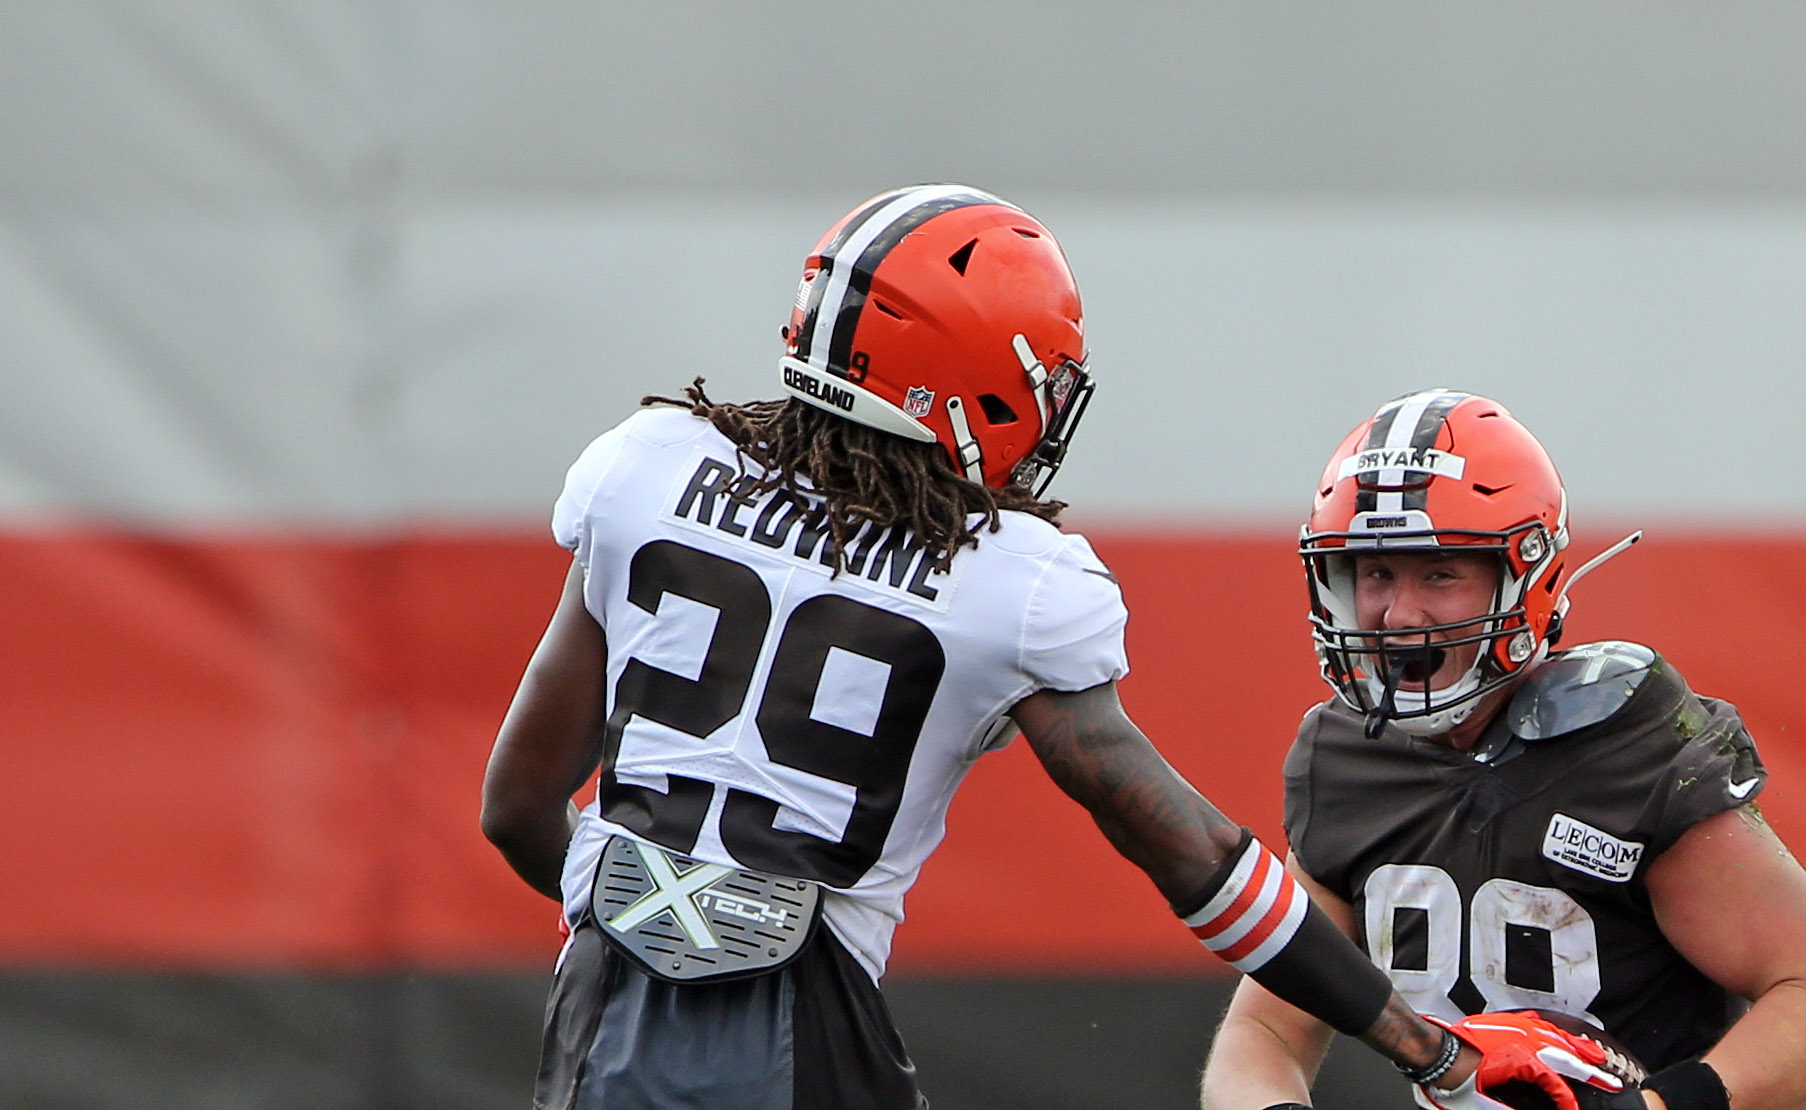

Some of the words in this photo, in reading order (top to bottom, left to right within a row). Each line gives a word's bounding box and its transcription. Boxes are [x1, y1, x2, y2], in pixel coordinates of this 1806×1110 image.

[784, 366, 855, 411] CLEVELAND
[1358, 451, 1440, 469] BRYANT
[1366, 517, 1407, 528] BROWNS
[599, 539, 946, 889] 29
[1551, 821, 1640, 862] LECOM
